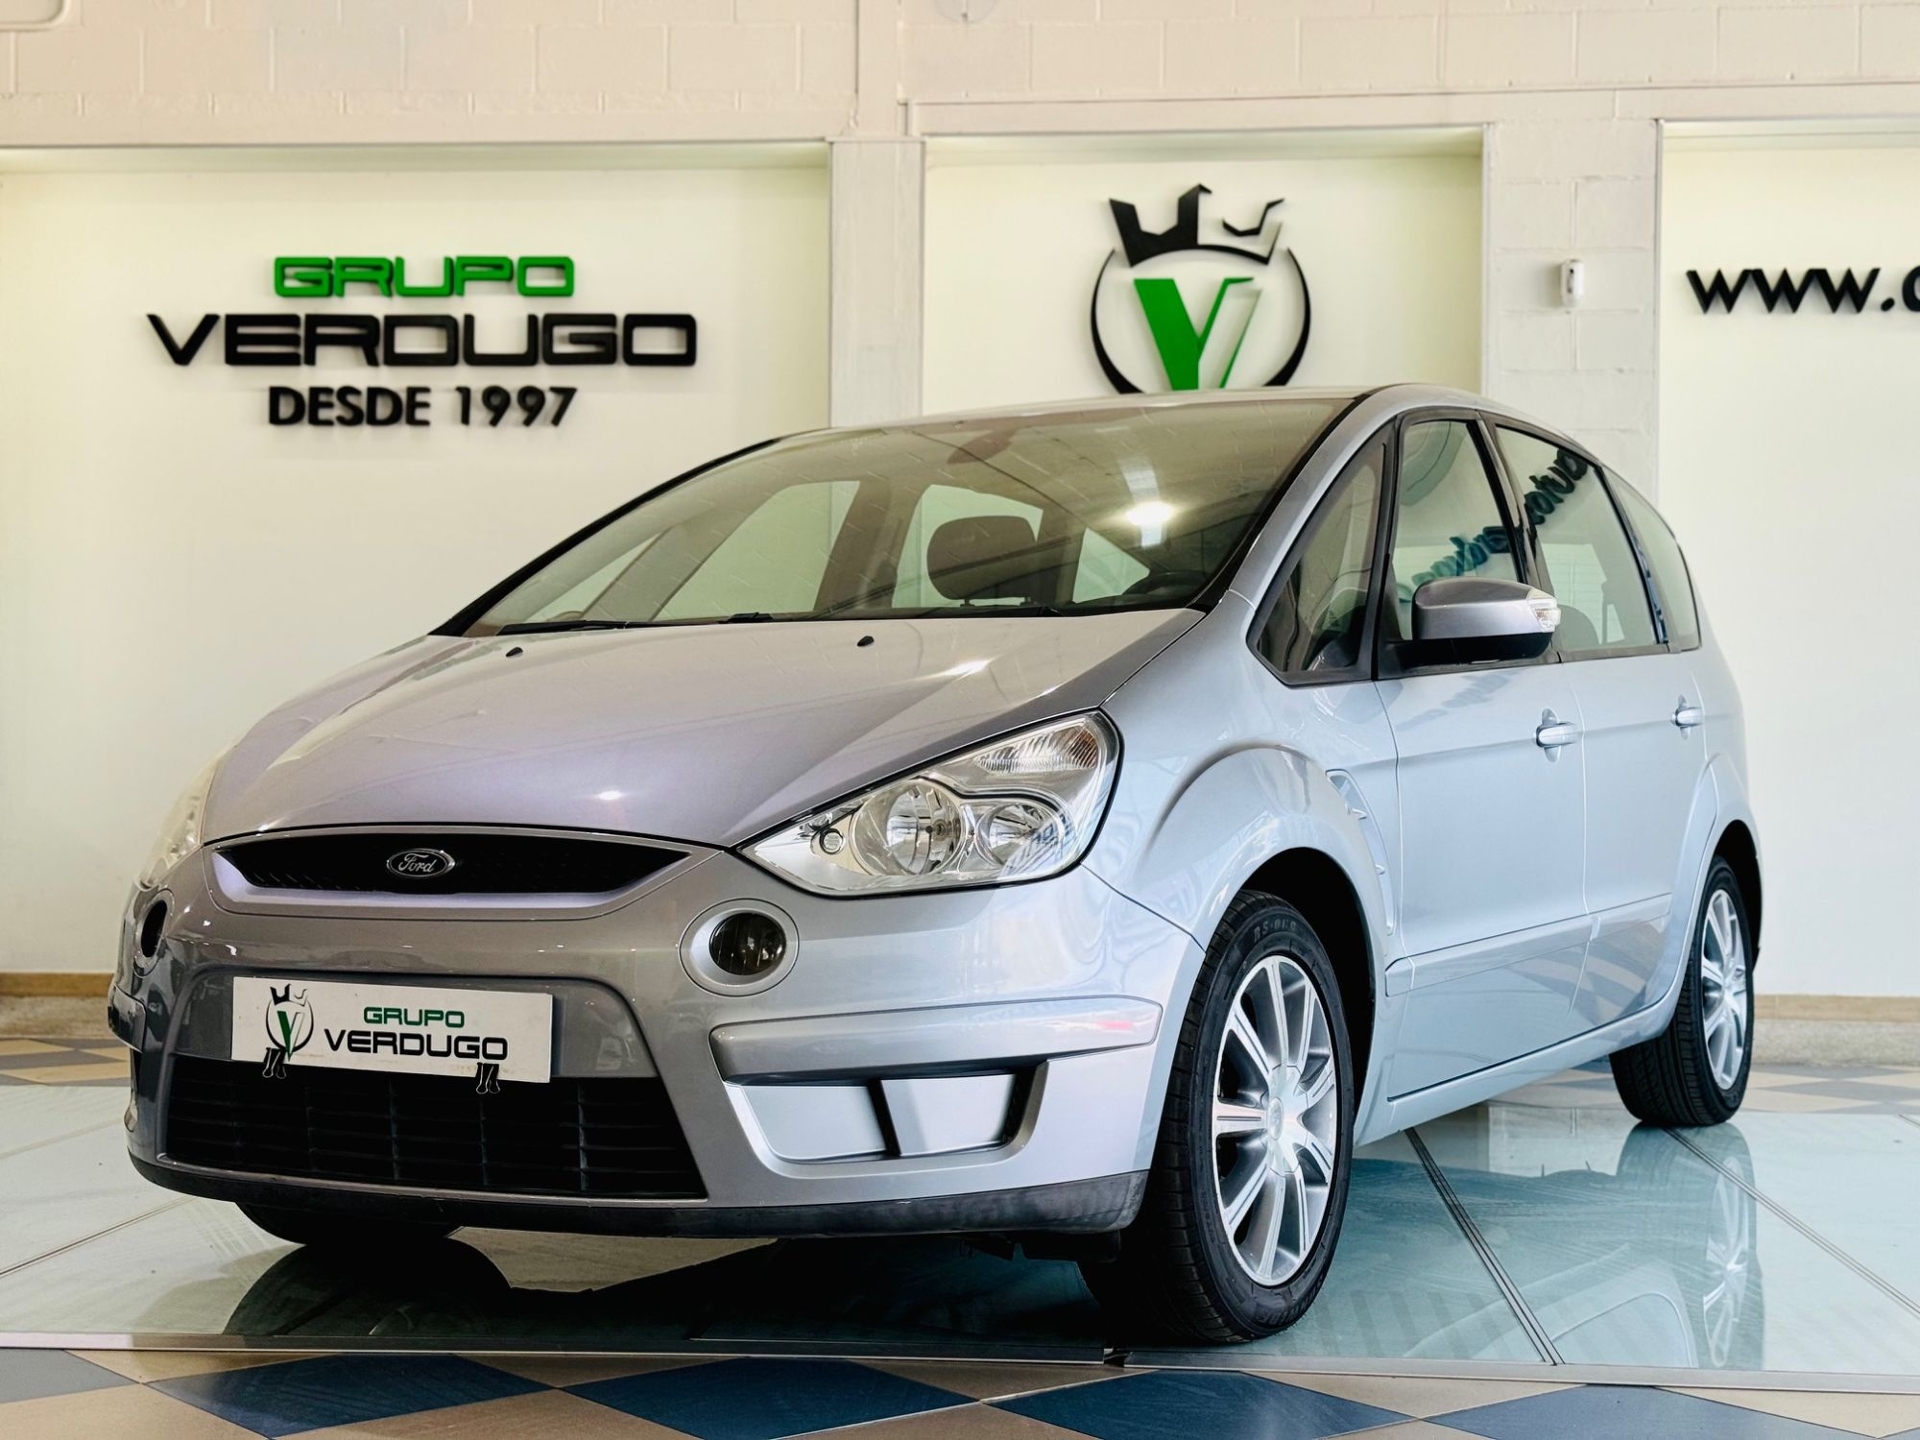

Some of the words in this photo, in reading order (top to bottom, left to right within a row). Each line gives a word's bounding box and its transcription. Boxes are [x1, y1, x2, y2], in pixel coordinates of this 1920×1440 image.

[274, 256, 574, 297] GRUPO
[147, 313, 697, 366] VERDUGO
[269, 386, 431, 426] DESDE
[455, 386, 578, 426] 1997
[398, 852, 437, 873] Ford
[363, 1006, 465, 1029] GRUPO
[324, 1028, 509, 1061] VERDUGO
